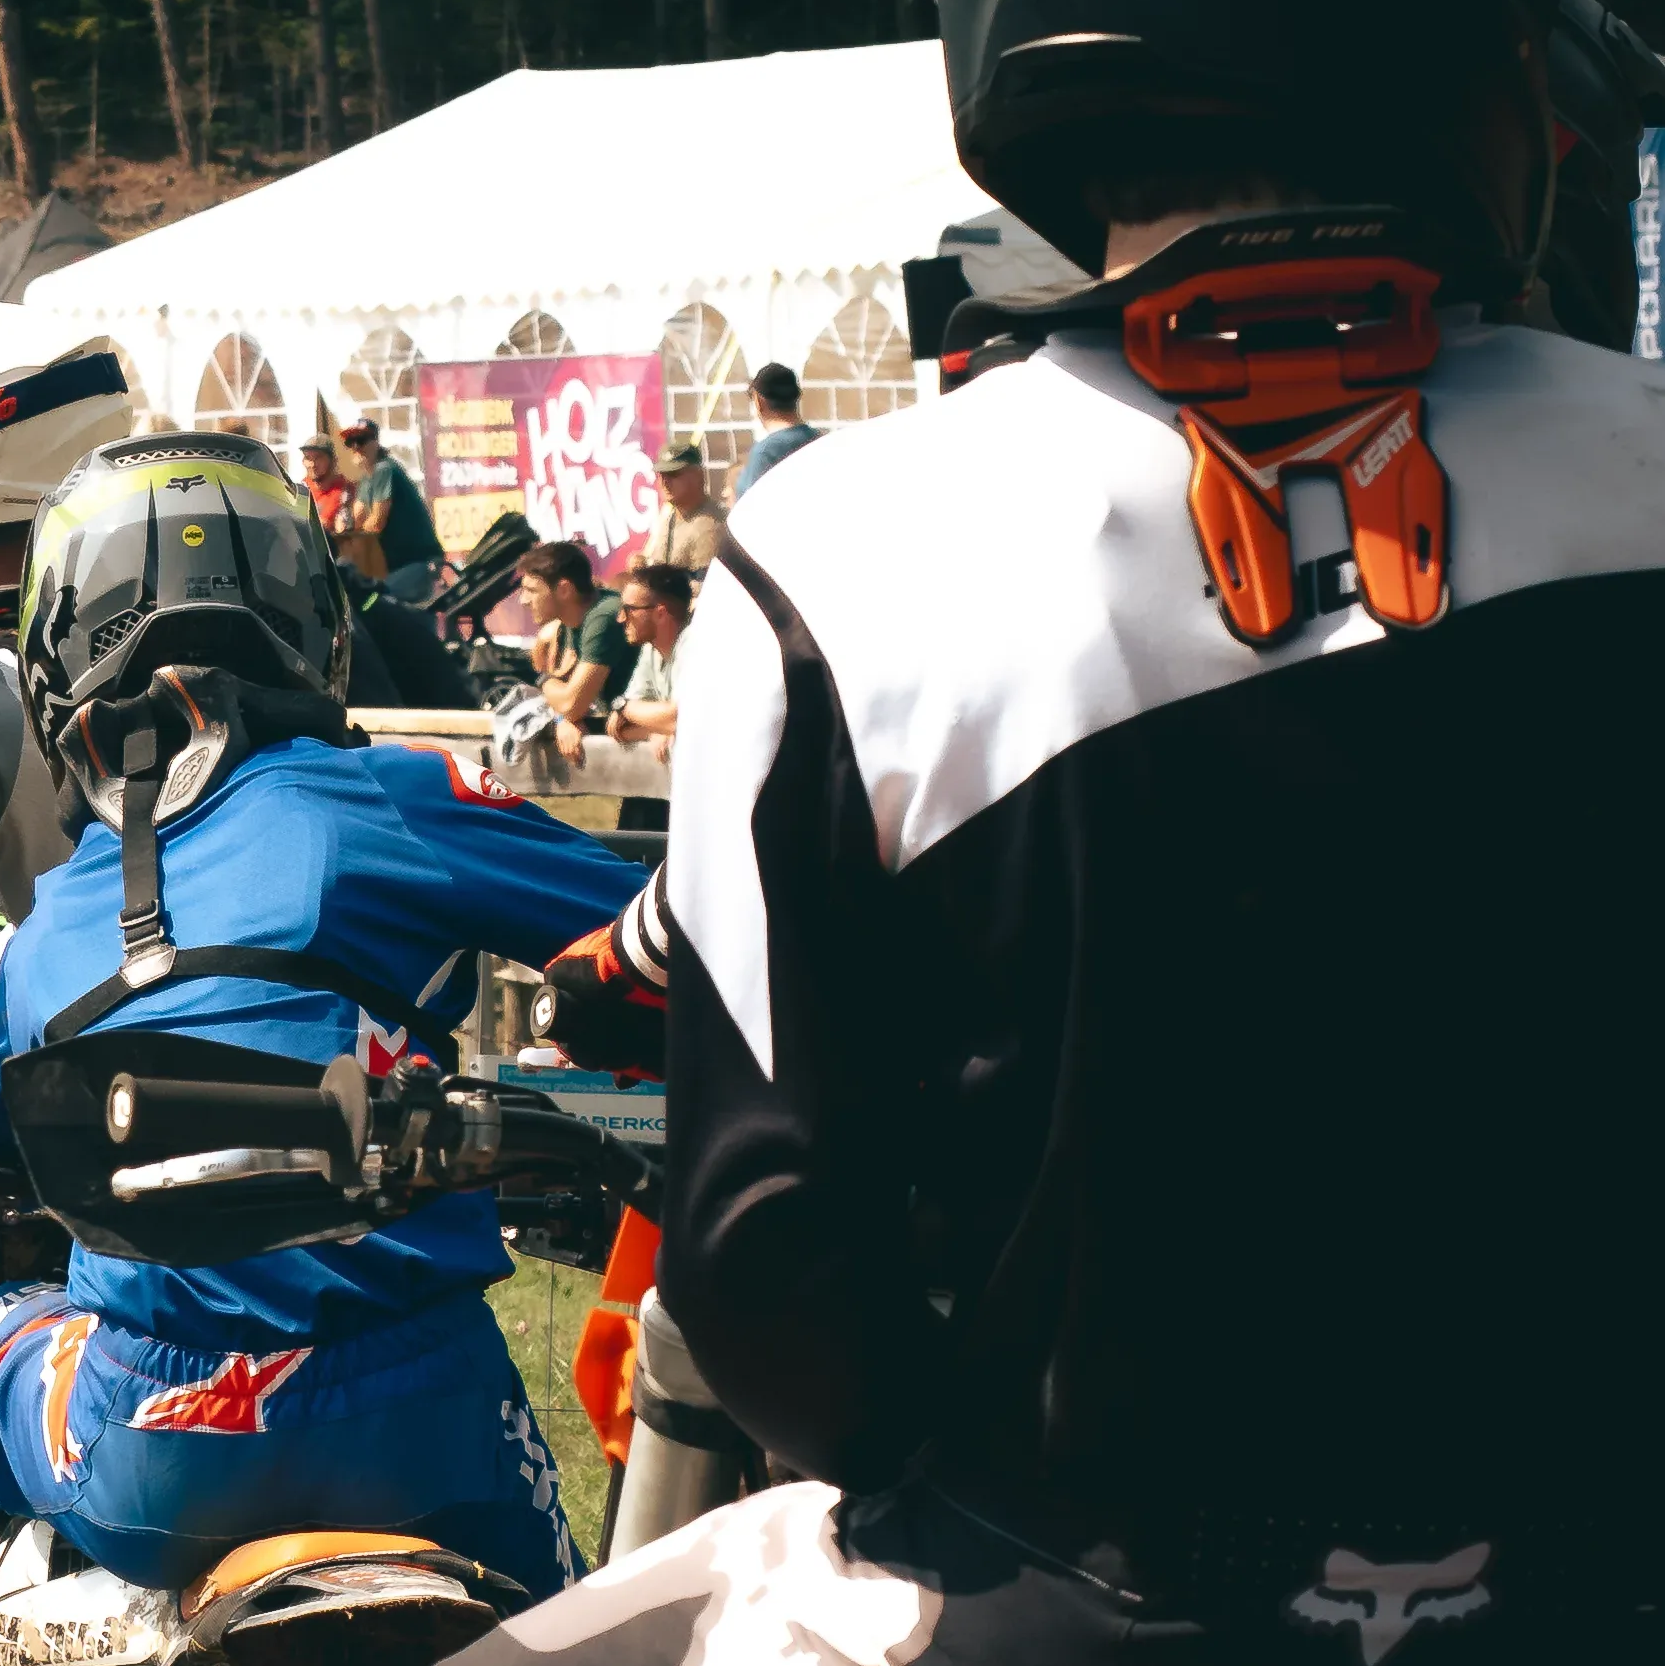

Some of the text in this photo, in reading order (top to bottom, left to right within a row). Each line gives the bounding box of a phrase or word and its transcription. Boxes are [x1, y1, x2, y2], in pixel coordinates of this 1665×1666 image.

[1636, 153, 1662, 360] POLARIS
[1350, 409, 1414, 488] LEATT
[577, 1116, 667, 1131] ABERKO
